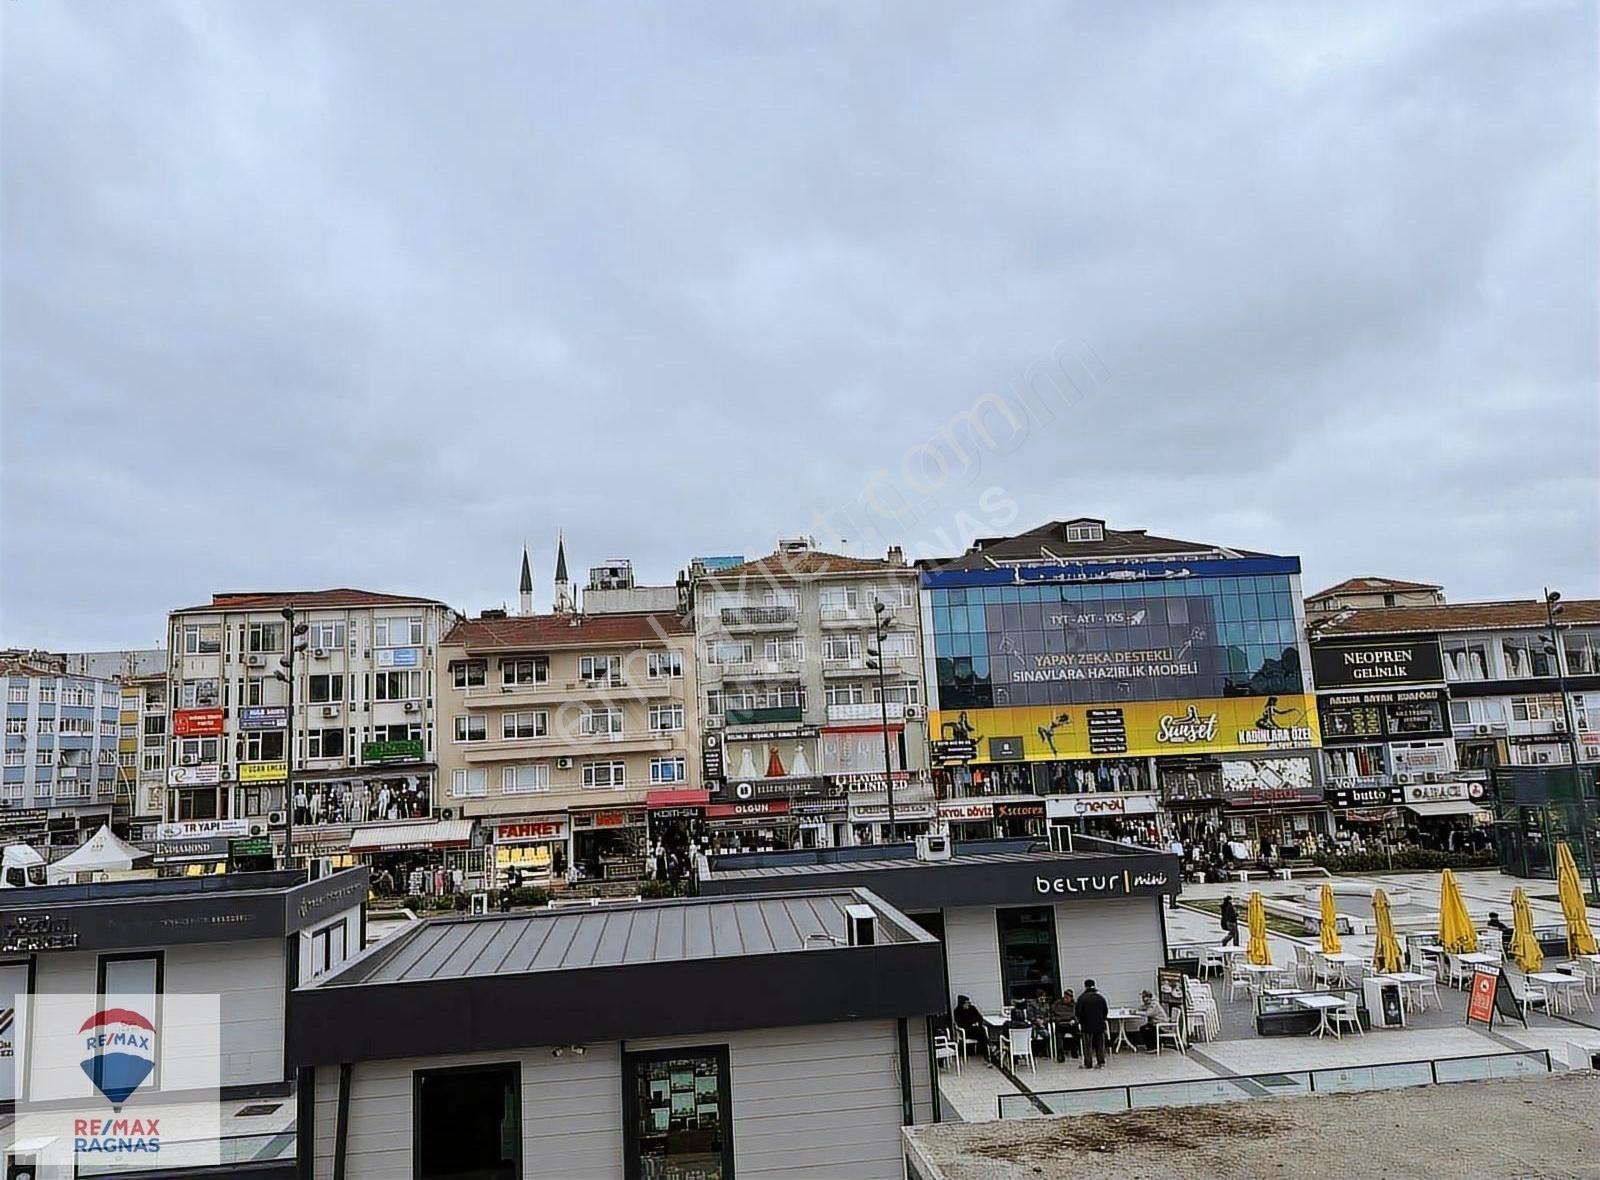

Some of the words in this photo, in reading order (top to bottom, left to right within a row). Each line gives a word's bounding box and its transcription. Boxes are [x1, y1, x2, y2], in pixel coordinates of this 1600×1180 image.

[1035, 655, 1074, 667] YAPAY
[1078, 653, 1110, 664] ZEKA
[1115, 648, 1173, 662] DESTEKLİ
[1344, 649, 1412, 664] NEOPREN
[1013, 667, 1085, 682] SINAVLARA
[1088, 664, 1147, 679] HAZIRLIK
[1149, 660, 1198, 676] MODELİ
[1353, 665, 1408, 678] GELİNLİK
[1157, 713, 1218, 742] Sunset
[735, 803, 769, 813] OLGUN
